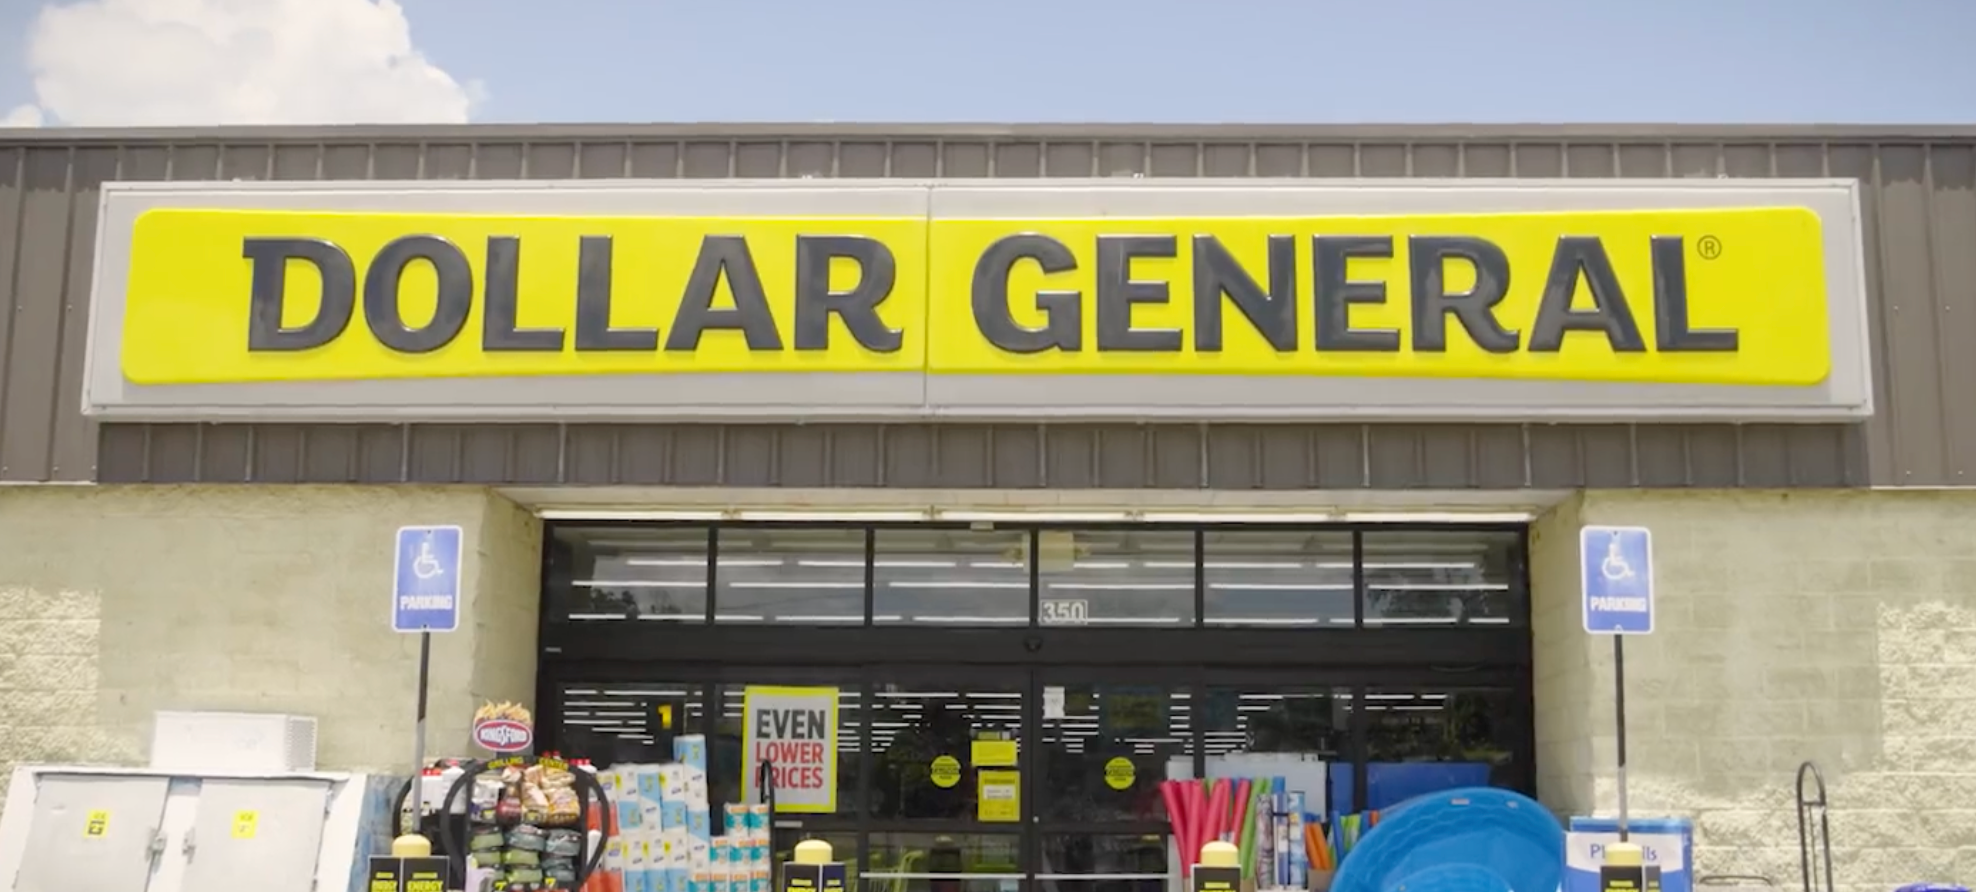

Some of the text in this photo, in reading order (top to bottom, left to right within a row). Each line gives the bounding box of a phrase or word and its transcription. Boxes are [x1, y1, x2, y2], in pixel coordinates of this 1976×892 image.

[242, 233, 904, 353] DOLLAR
[971, 232, 1739, 353] GENERAL
[400, 595, 452, 610] PARKING
[1043, 602, 1084, 623] 350
[1590, 596, 1647, 612] PARKING
[658, 704, 672, 729] 1
[756, 709, 825, 739] EVEN
[480, 725, 527, 746] KINGSFORD
[755, 742, 824, 763] LOWER
[539, 757, 569, 771] CENTER
